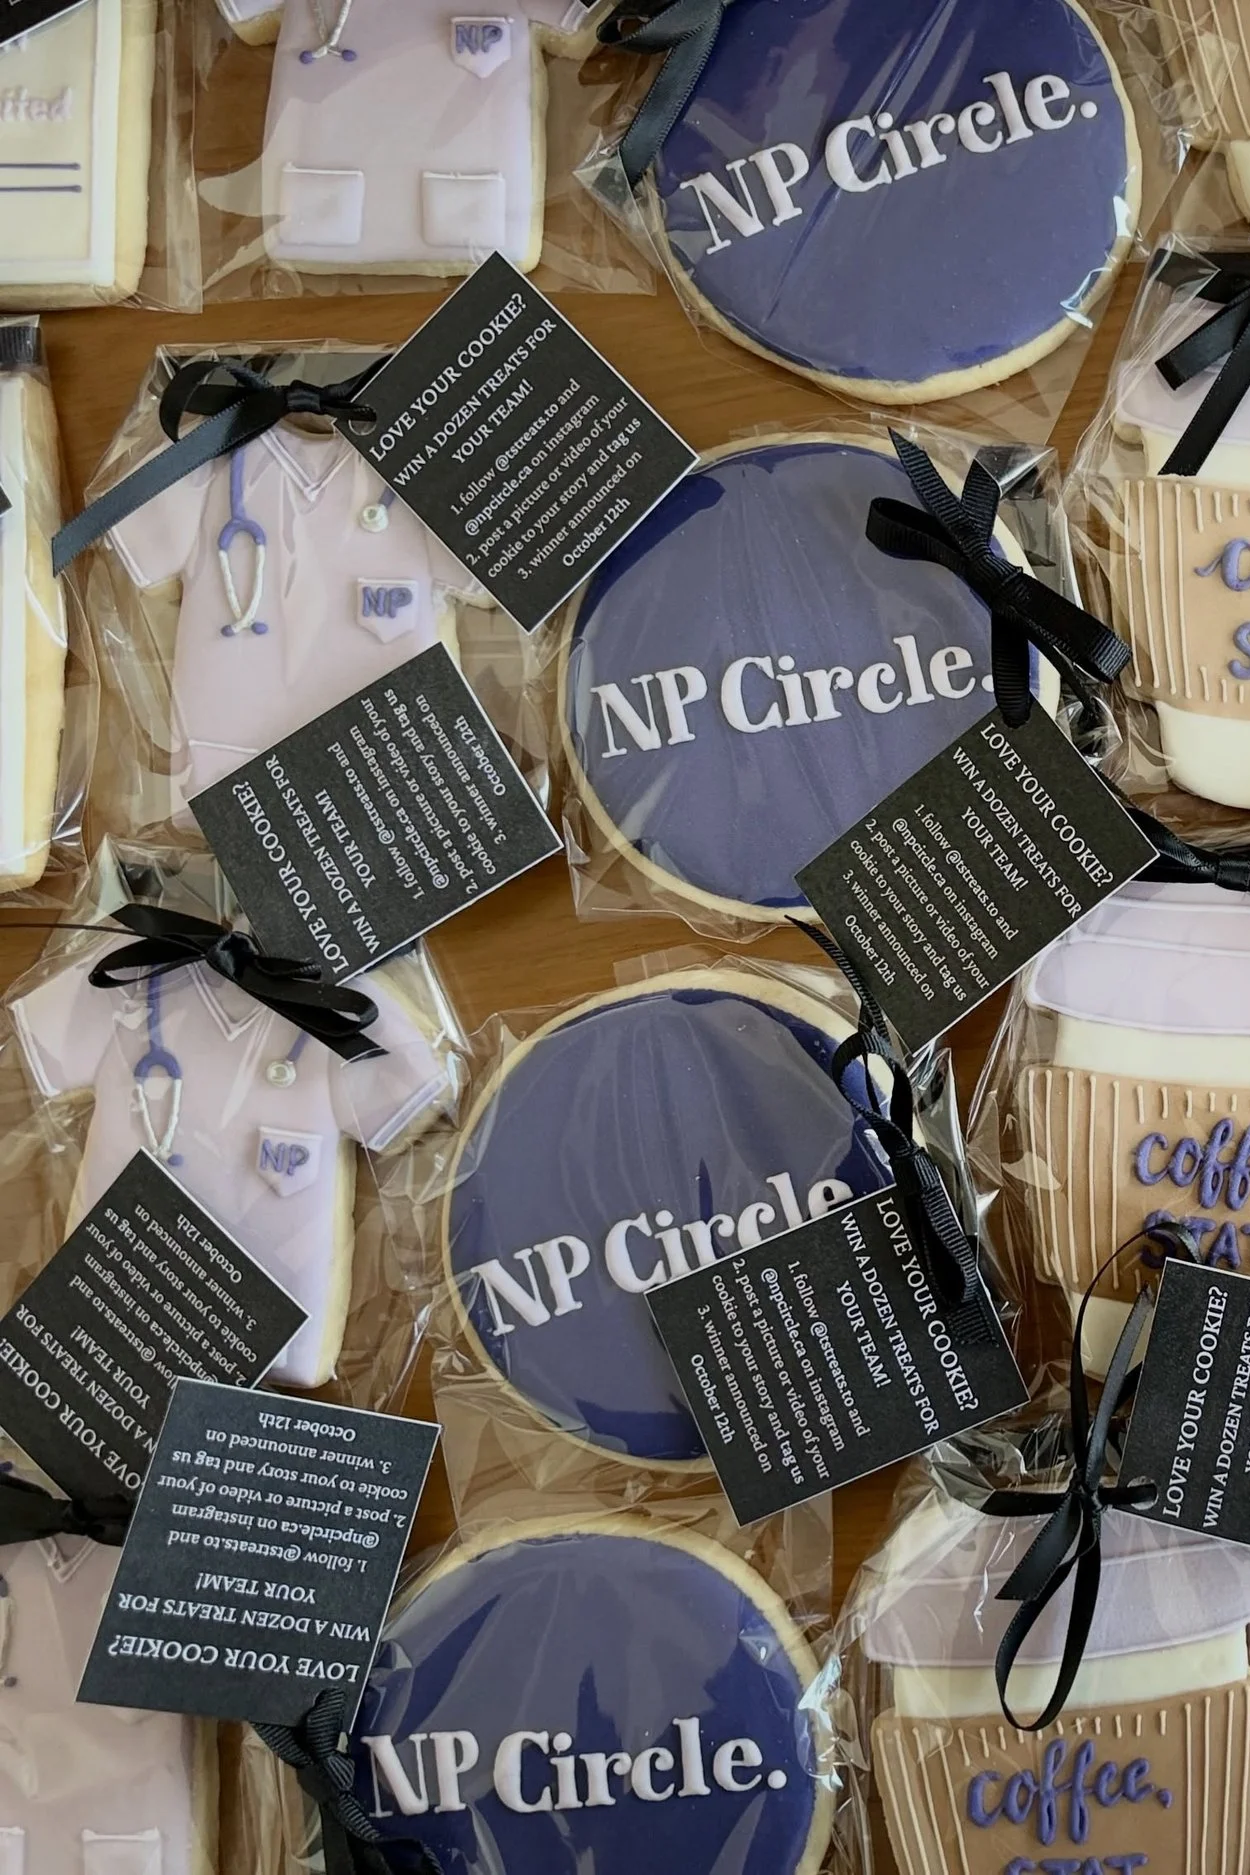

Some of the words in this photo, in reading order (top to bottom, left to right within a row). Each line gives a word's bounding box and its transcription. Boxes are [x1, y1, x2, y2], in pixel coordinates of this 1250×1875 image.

[455, 24, 504, 56] NP
[679, 142, 810, 255] NP
[824, 71, 1098, 193] Circle.
[368, 410, 417, 462] LOVE
[409, 365, 462, 416] YOUR
[456, 292, 527, 368] COOKIE?
[561, 519, 607, 567] October
[602, 497, 631, 524] 12th
[362, 586, 413, 618] NP
[590, 666, 708, 759] NP
[721, 634, 994, 734] Circle.
[452, 714, 477, 745] 12th
[469, 742, 506, 796] October
[231, 780, 286, 862] COOKIE?
[979, 721, 1022, 771] LOVE
[1013, 763, 1056, 819] YOUR
[1050, 813, 1114, 888] COOKIE?
[277, 859, 317, 921] YOUR
[307, 916, 350, 974] LOVE
[844, 913, 879, 961] October
[873, 957, 896, 986] 12th
[260, 1138, 310, 1176] NP
[470, 1235, 590, 1337] NP
[875, 1196, 913, 1257] LOVE
[900, 1254, 937, 1320] YOUR
[926, 1319, 979, 1411] COOKIE?
[1191, 1285, 1228, 1385] COOKIE?
[689, 1353, 721, 1411] October
[712, 1410, 736, 1444] 12th
[1175, 1388, 1207, 1452] YOUR
[58, 1402, 106, 1458] YOUR
[102, 1449, 141, 1490] OVE
[1161, 1455, 1192, 1519] LOVE
[117, 1591, 160, 1613] FOR
[161, 1598, 237, 1623] TREATS
[239, 1608, 312, 1633] DOZEN
[313, 1618, 329, 1635] A
[106, 1633, 219, 1664] COOKIE?
[223, 1646, 290, 1674] YOUR
[328, 1621, 370, 1642] WIN
[294, 1656, 360, 1683] LOVE
[360, 1729, 480, 1818] NP
[493, 1716, 788, 1813] Circle.
